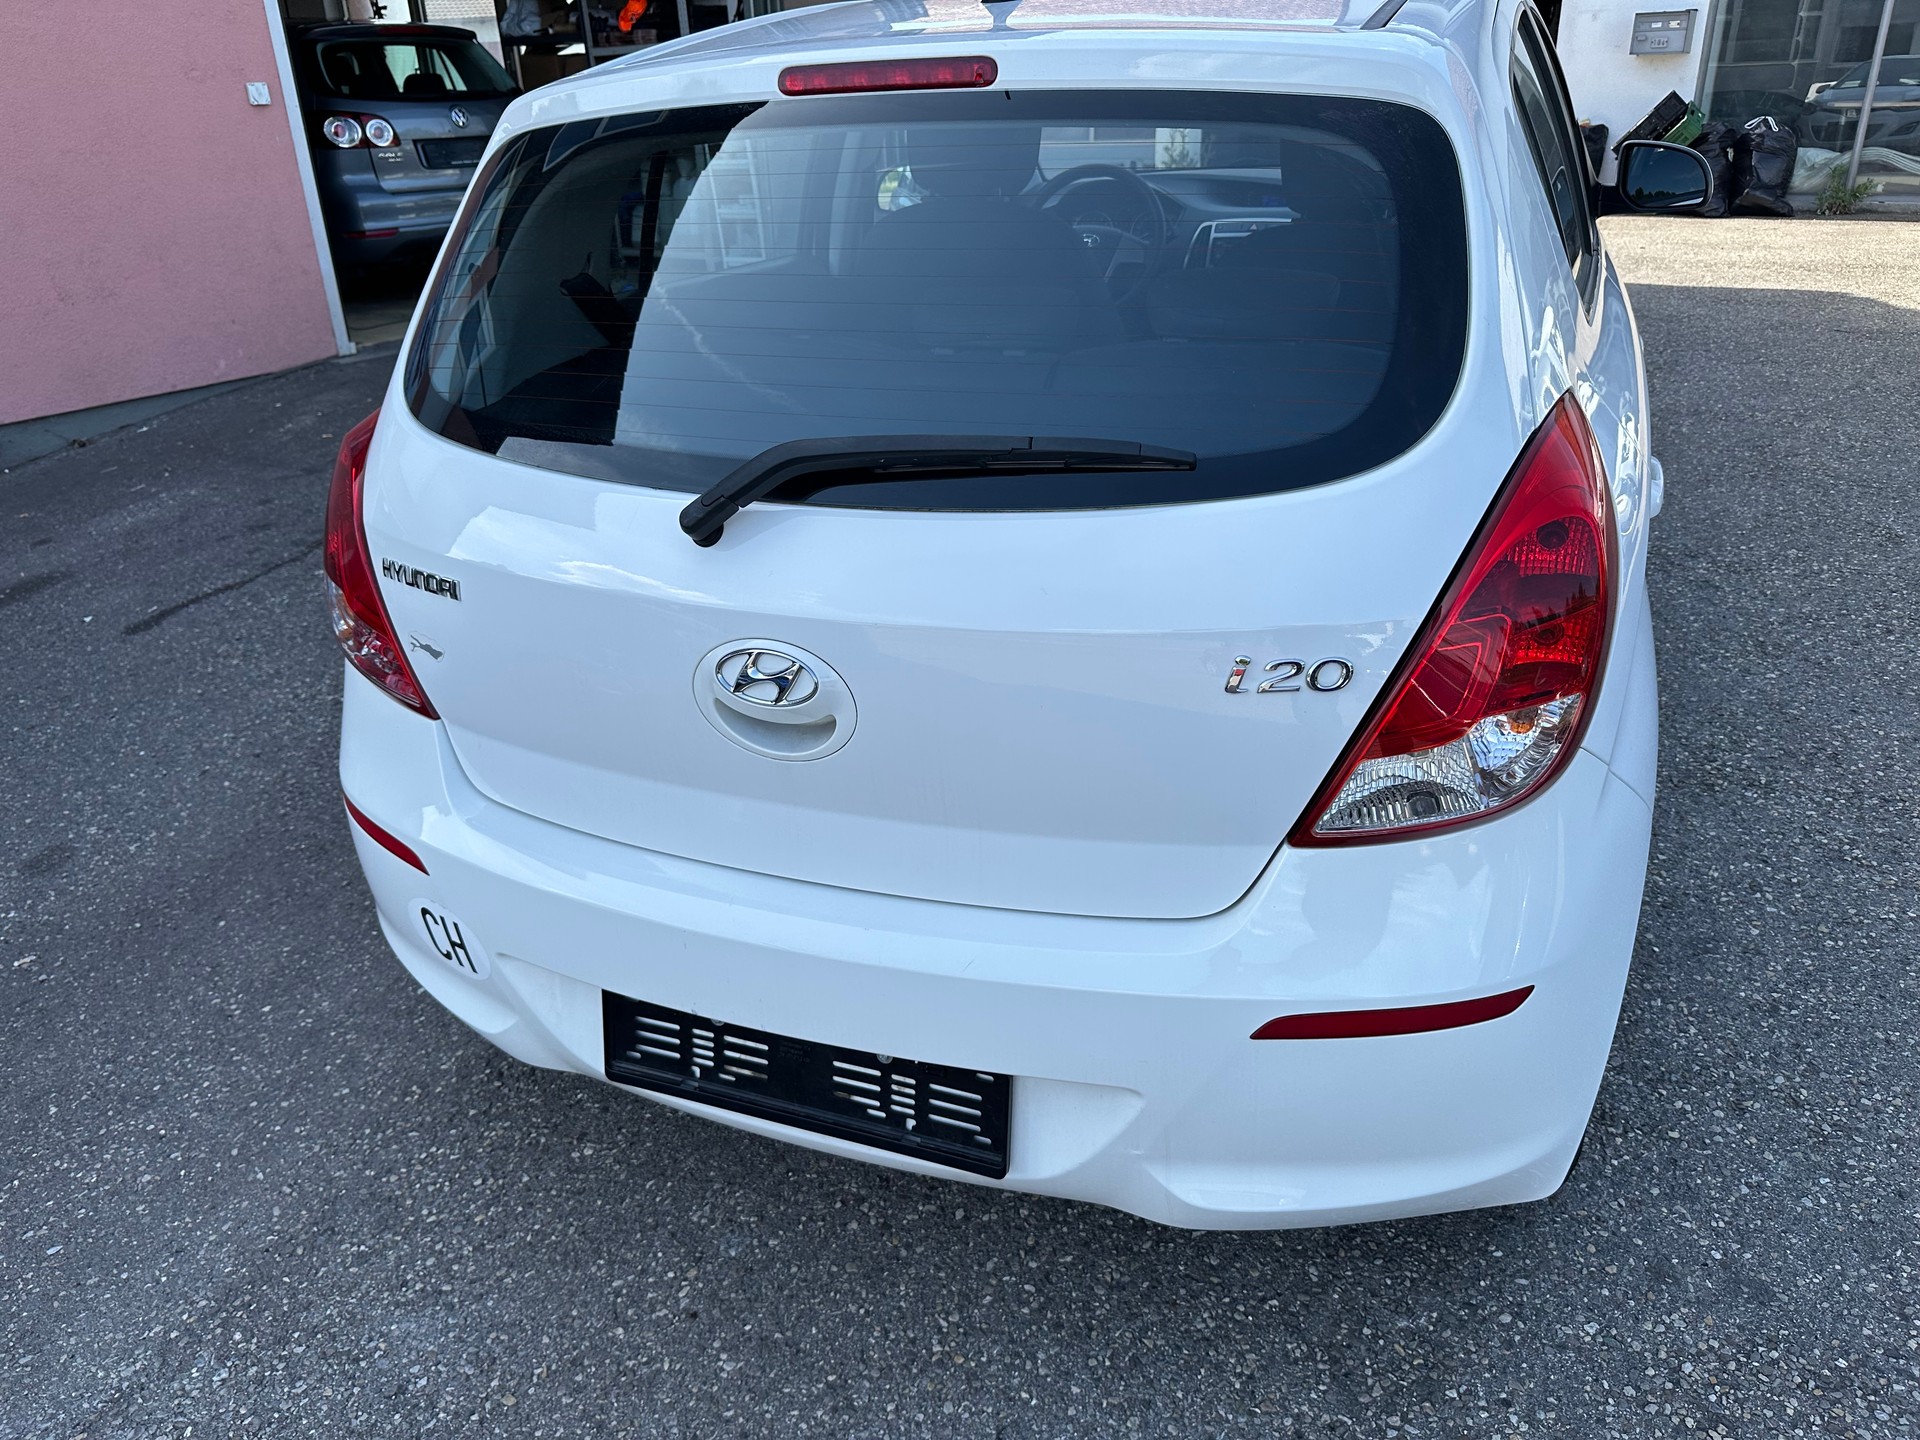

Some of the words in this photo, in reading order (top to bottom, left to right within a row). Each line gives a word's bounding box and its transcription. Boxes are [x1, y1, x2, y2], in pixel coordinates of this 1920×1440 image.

[382, 557, 462, 601] HYUNDAI
[1225, 655, 1354, 693] i20
[421, 906, 478, 974] CH
